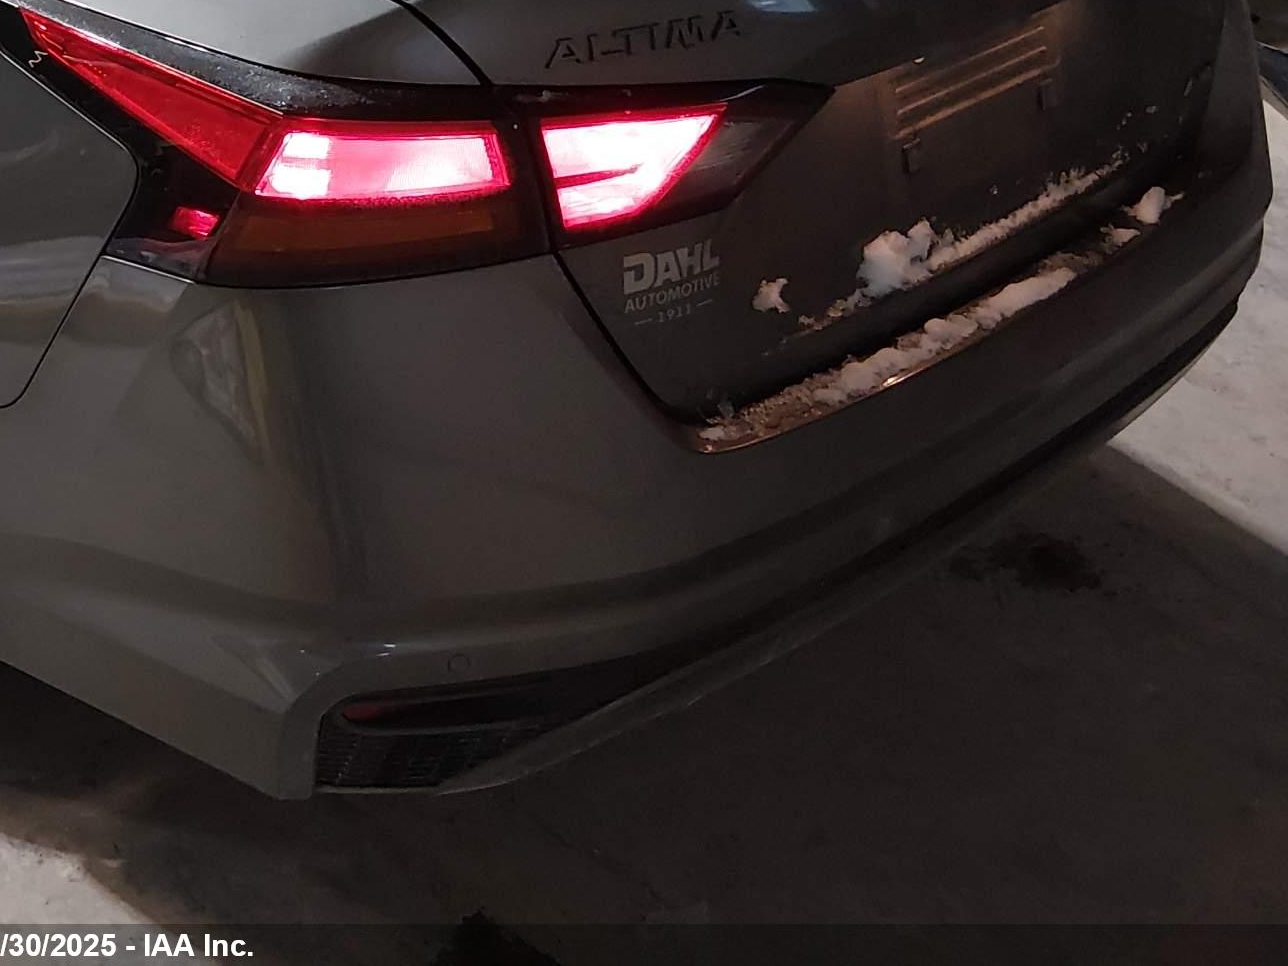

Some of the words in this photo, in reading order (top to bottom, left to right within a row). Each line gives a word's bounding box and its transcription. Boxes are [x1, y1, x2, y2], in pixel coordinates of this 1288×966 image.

[544, 10, 741, 69] ALTIMA
[623, 238, 720, 295] DAHL
[623, 270, 721, 314] AUTOMOTIVE
